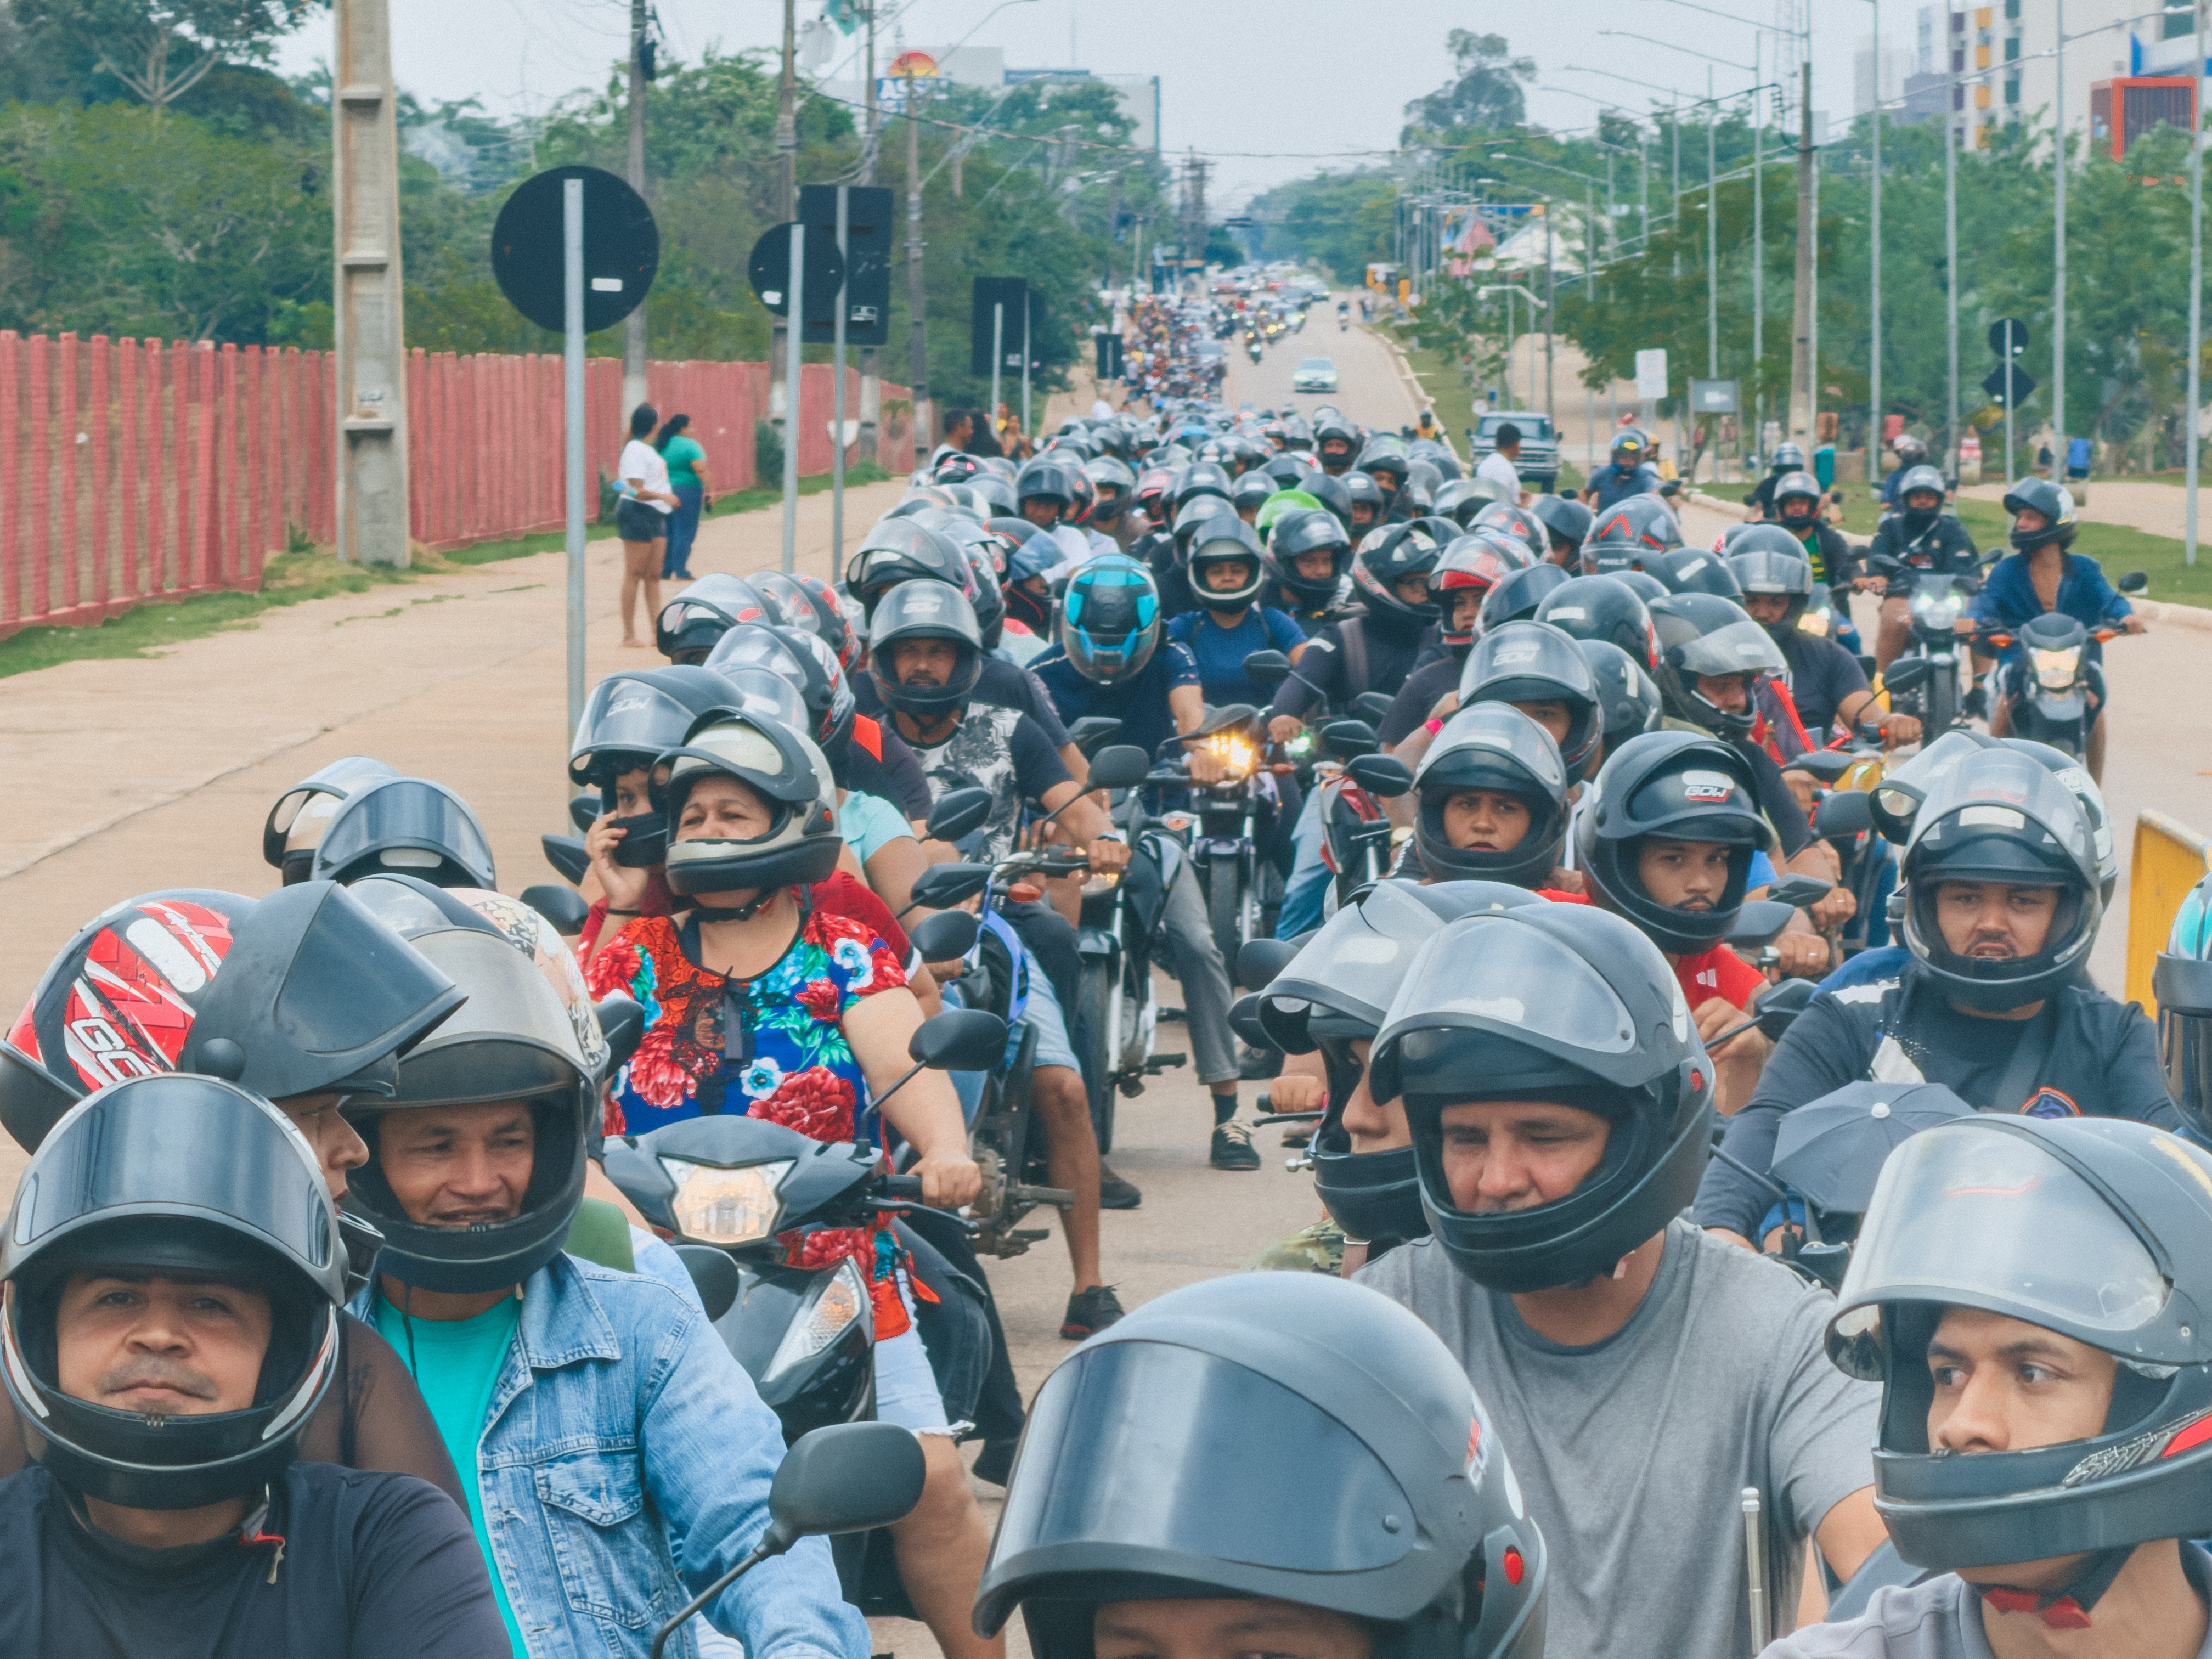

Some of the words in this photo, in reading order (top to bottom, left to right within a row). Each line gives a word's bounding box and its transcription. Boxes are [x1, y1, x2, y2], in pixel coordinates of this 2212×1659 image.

[1492, 651, 1537, 667] GOW
[606, 697, 651, 717] GOW
[1685, 785, 1728, 798] GOW
[71, 1018, 152, 1082] GO
